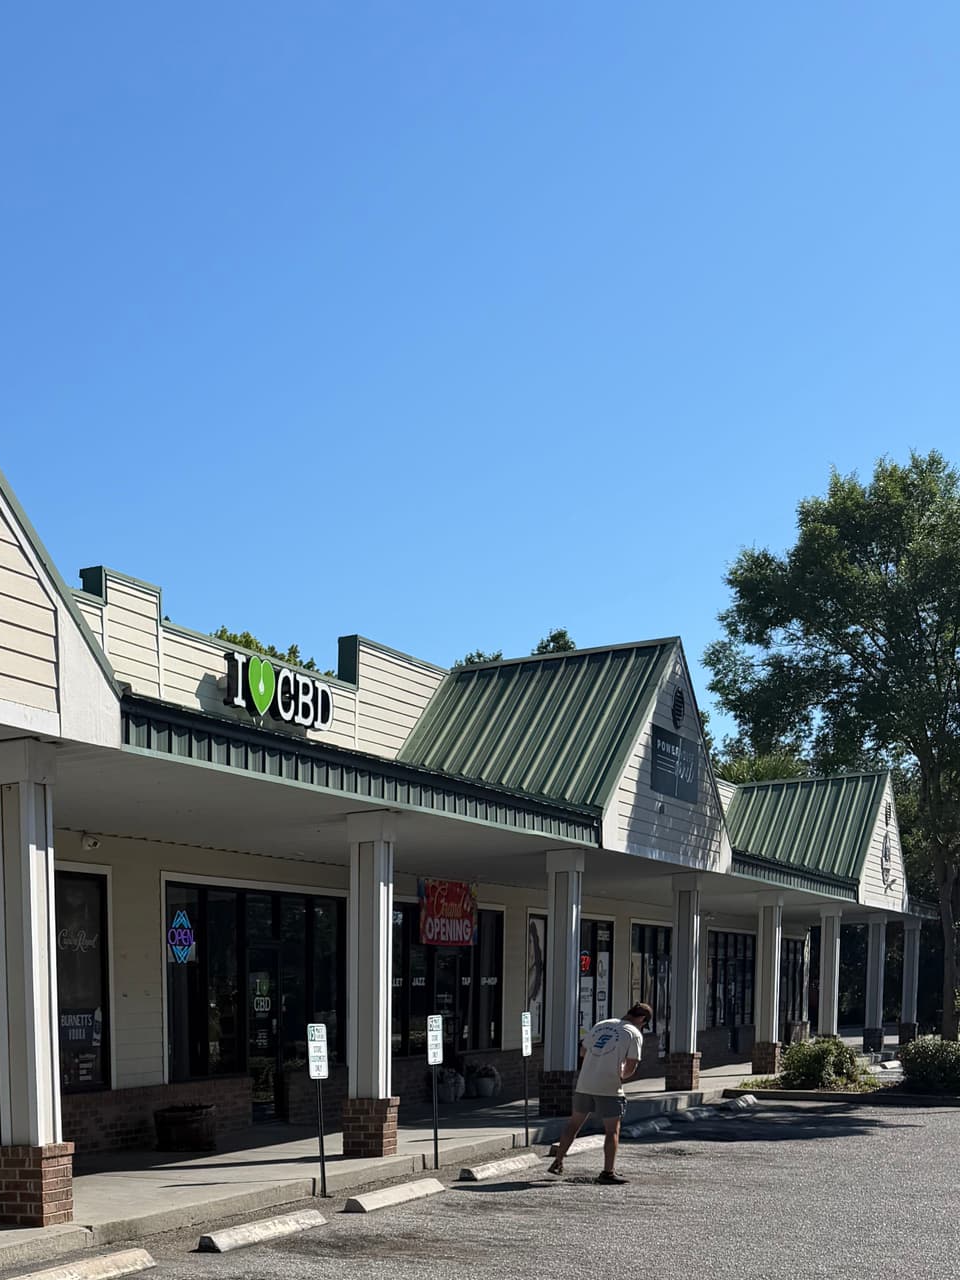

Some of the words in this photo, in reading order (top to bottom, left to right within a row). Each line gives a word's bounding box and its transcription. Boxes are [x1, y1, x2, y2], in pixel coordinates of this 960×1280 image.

[233, 652, 247, 708] I
[277, 668, 333, 731] CBD
[168, 928, 194, 945] OPEN
[425, 917, 472, 942] OPENING
